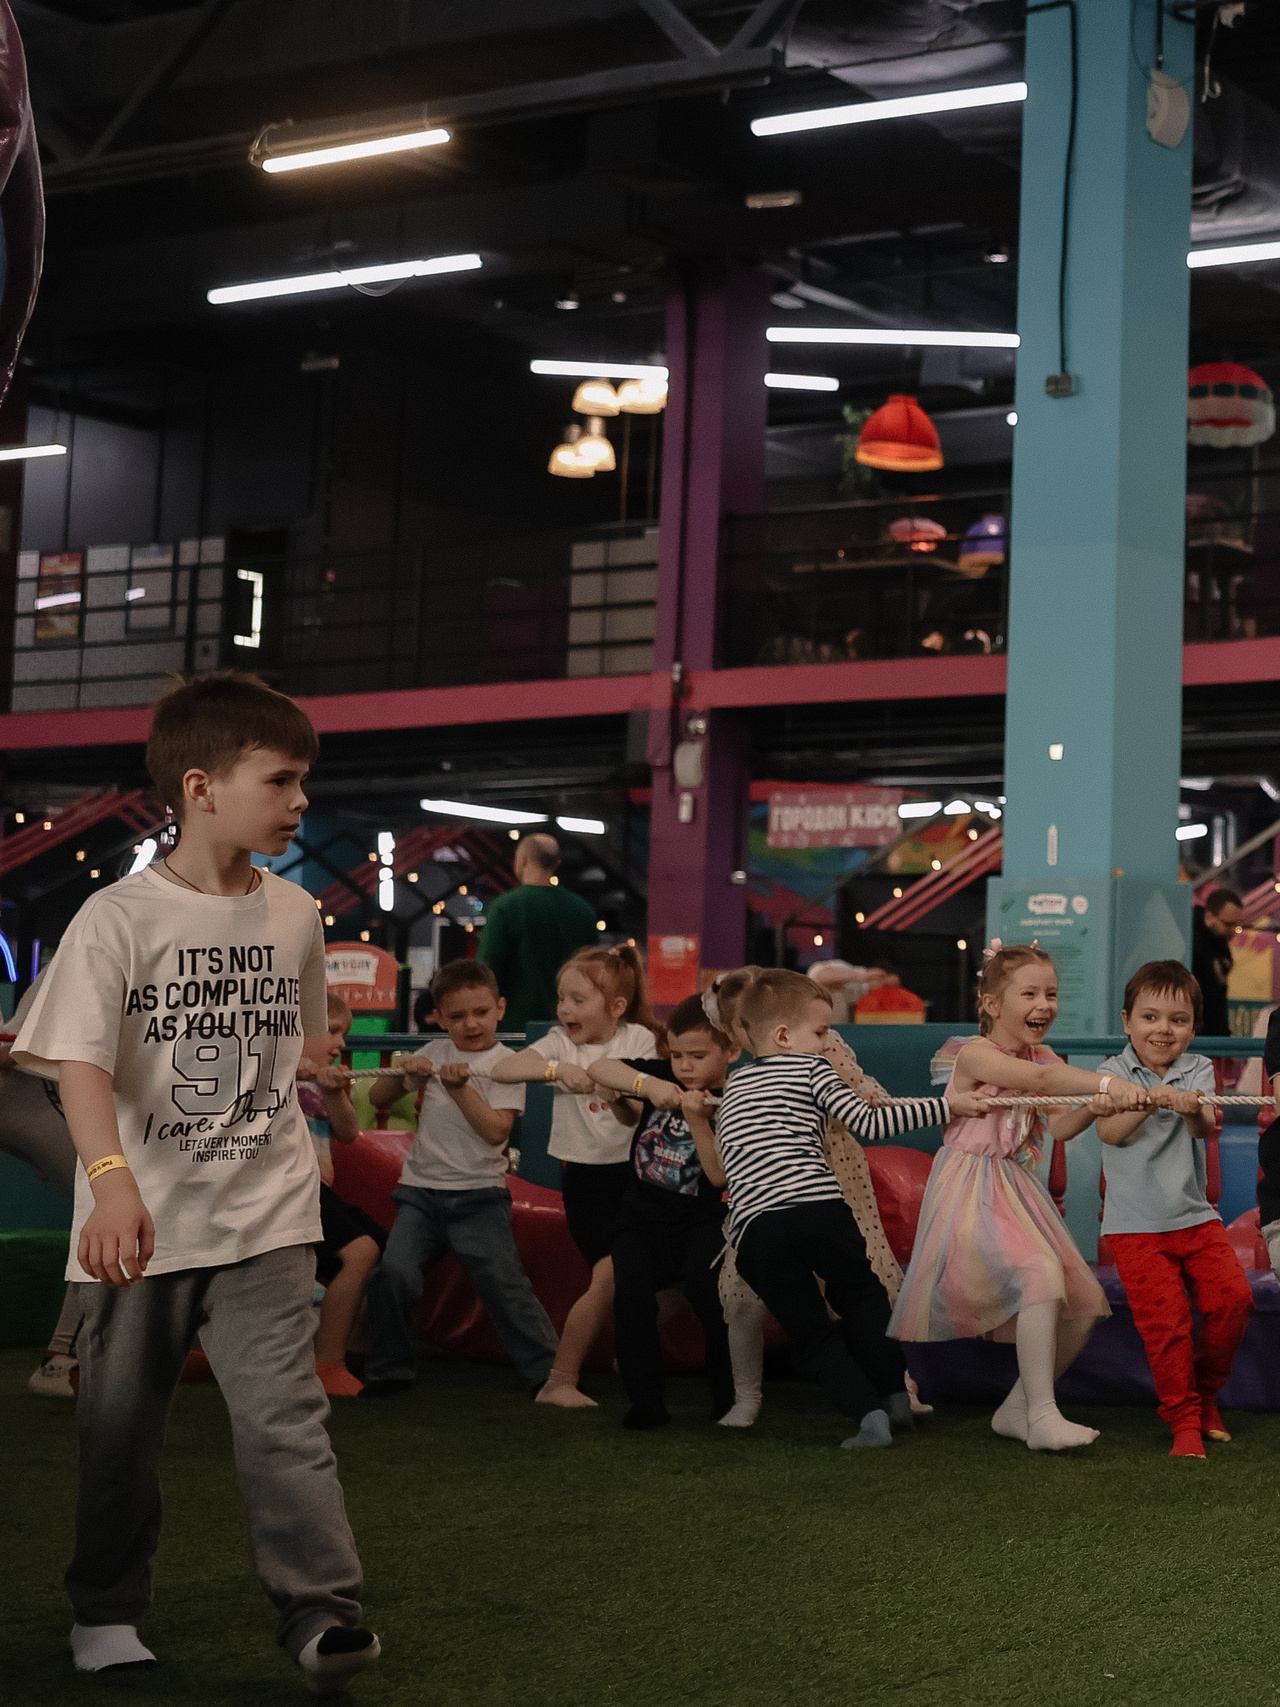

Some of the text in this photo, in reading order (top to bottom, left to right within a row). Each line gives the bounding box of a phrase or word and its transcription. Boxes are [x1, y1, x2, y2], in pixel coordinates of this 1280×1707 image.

[849, 803, 900, 829] KIDS
[178, 945, 275, 976] IT'S NOT
[126, 985, 158, 1016] AS
[144, 1016, 177, 1043] AS
[185, 1012, 236, 1040] YOU
[172, 1022, 281, 1115] 91
[143, 1113, 154, 1145] I
[179, 1133, 272, 1152] LET EVERY MOMENT
[192, 1147, 259, 1162] INSPIRE YOU
